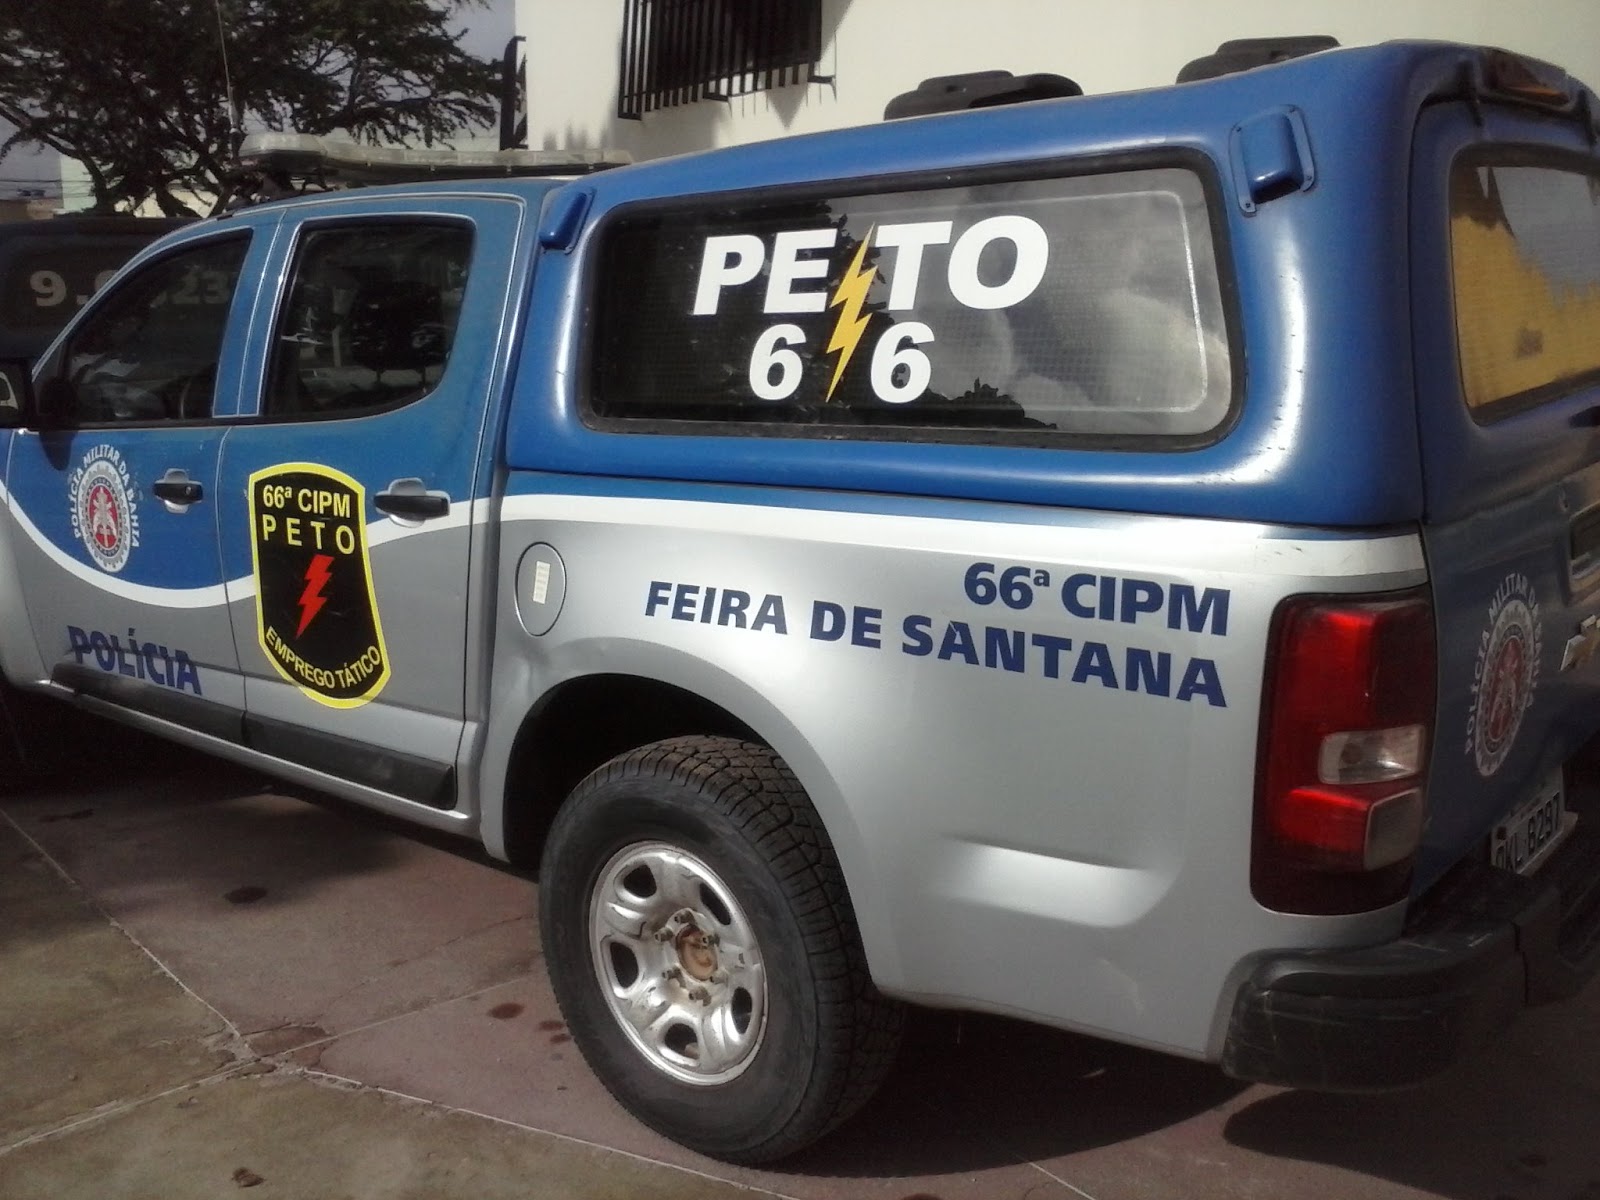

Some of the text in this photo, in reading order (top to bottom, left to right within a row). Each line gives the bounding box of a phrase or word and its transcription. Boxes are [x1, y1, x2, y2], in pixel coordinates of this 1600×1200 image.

[83, 444, 120, 468] MILITAR
[120, 460, 130, 486] DA
[126, 488, 140, 547] BAHIA
[298, 488, 350, 518] CIPM
[262, 514, 356, 555] PETO
[1061, 573, 1231, 636] CIPM
[1488, 572, 1528, 625] MILITAR
[67, 624, 203, 696] POLÍCIA
[265, 625, 382, 689] EMPREGO TÁTICO
[645, 580, 1228, 708] FEIRA DE SANTANA
